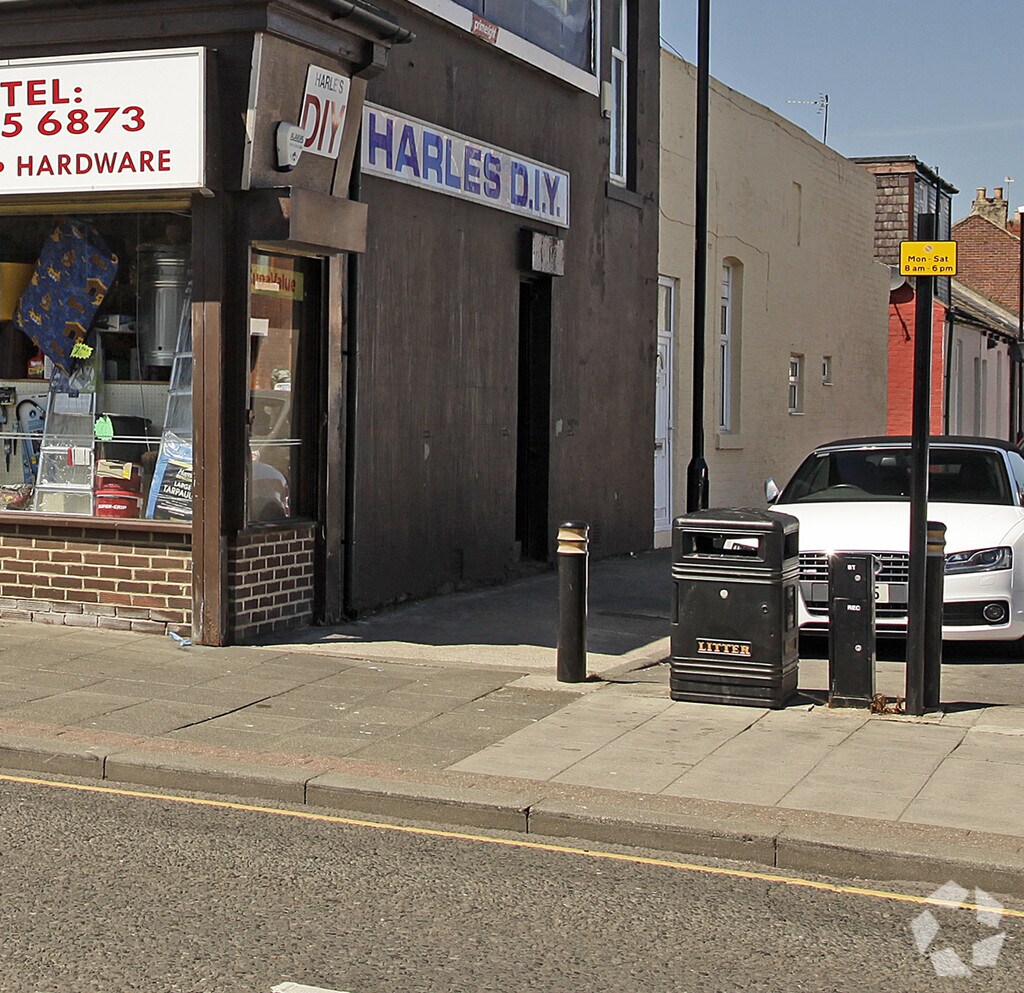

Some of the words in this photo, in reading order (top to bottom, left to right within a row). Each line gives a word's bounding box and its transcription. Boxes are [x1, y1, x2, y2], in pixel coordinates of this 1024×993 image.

[0, 79, 82, 106] TEL:
[37, 106, 146, 136] 6873
[301, 93, 346, 154] DIY
[17, 149, 172, 177] HARDWARE
[369, 112, 501, 199] HARLES
[511, 160, 560, 217] D.I.Y.
[933, 255, 949, 263] Sat
[697, 641, 751, 656] LITTER
